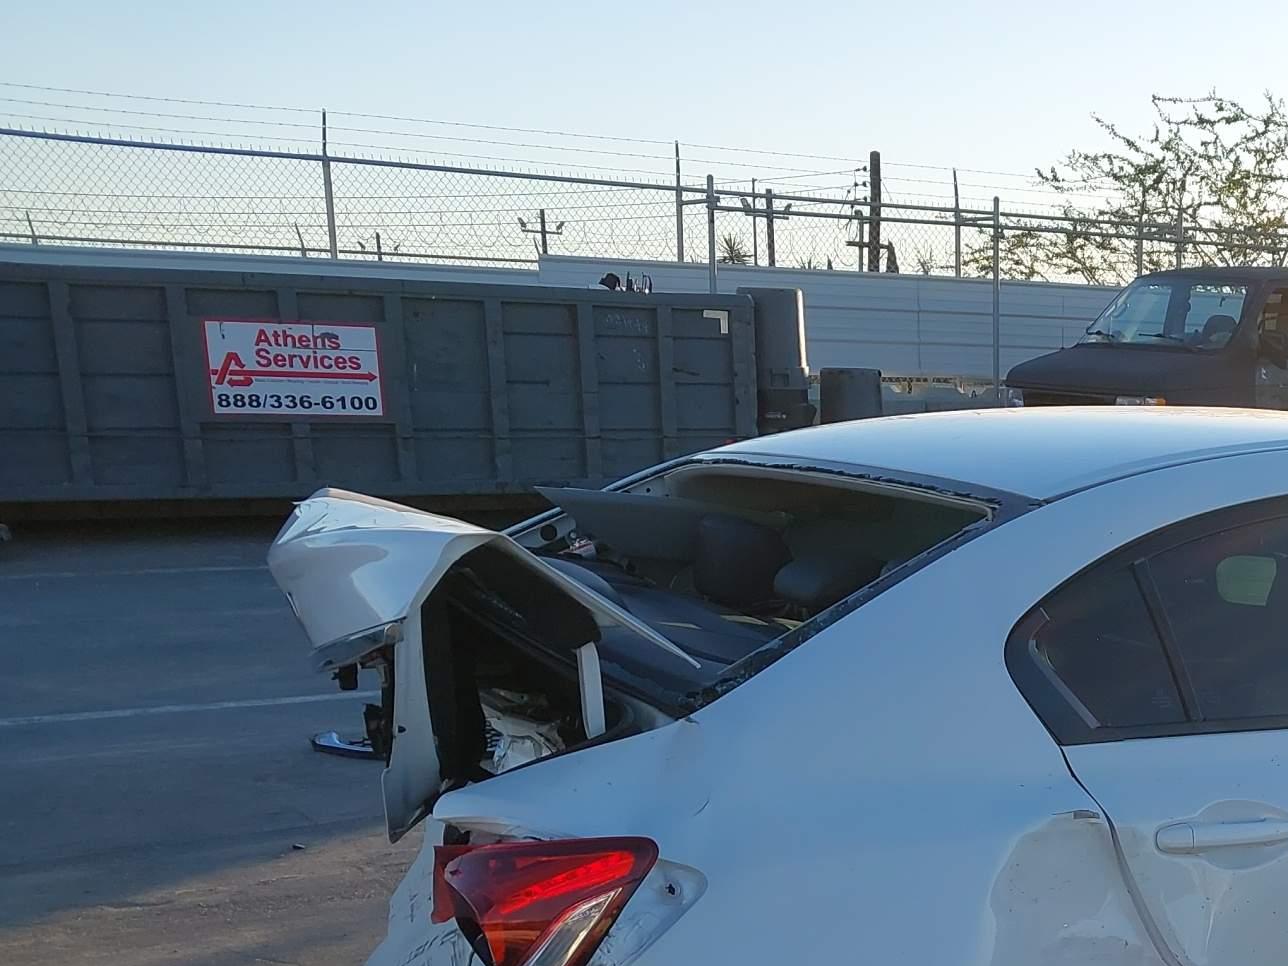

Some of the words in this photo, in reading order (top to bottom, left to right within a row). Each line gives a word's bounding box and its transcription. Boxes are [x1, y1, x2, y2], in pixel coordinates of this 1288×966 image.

[255, 328, 341, 350] Athens
[255, 348, 362, 370] Services
[217, 393, 378, 411] 888/336-6100
